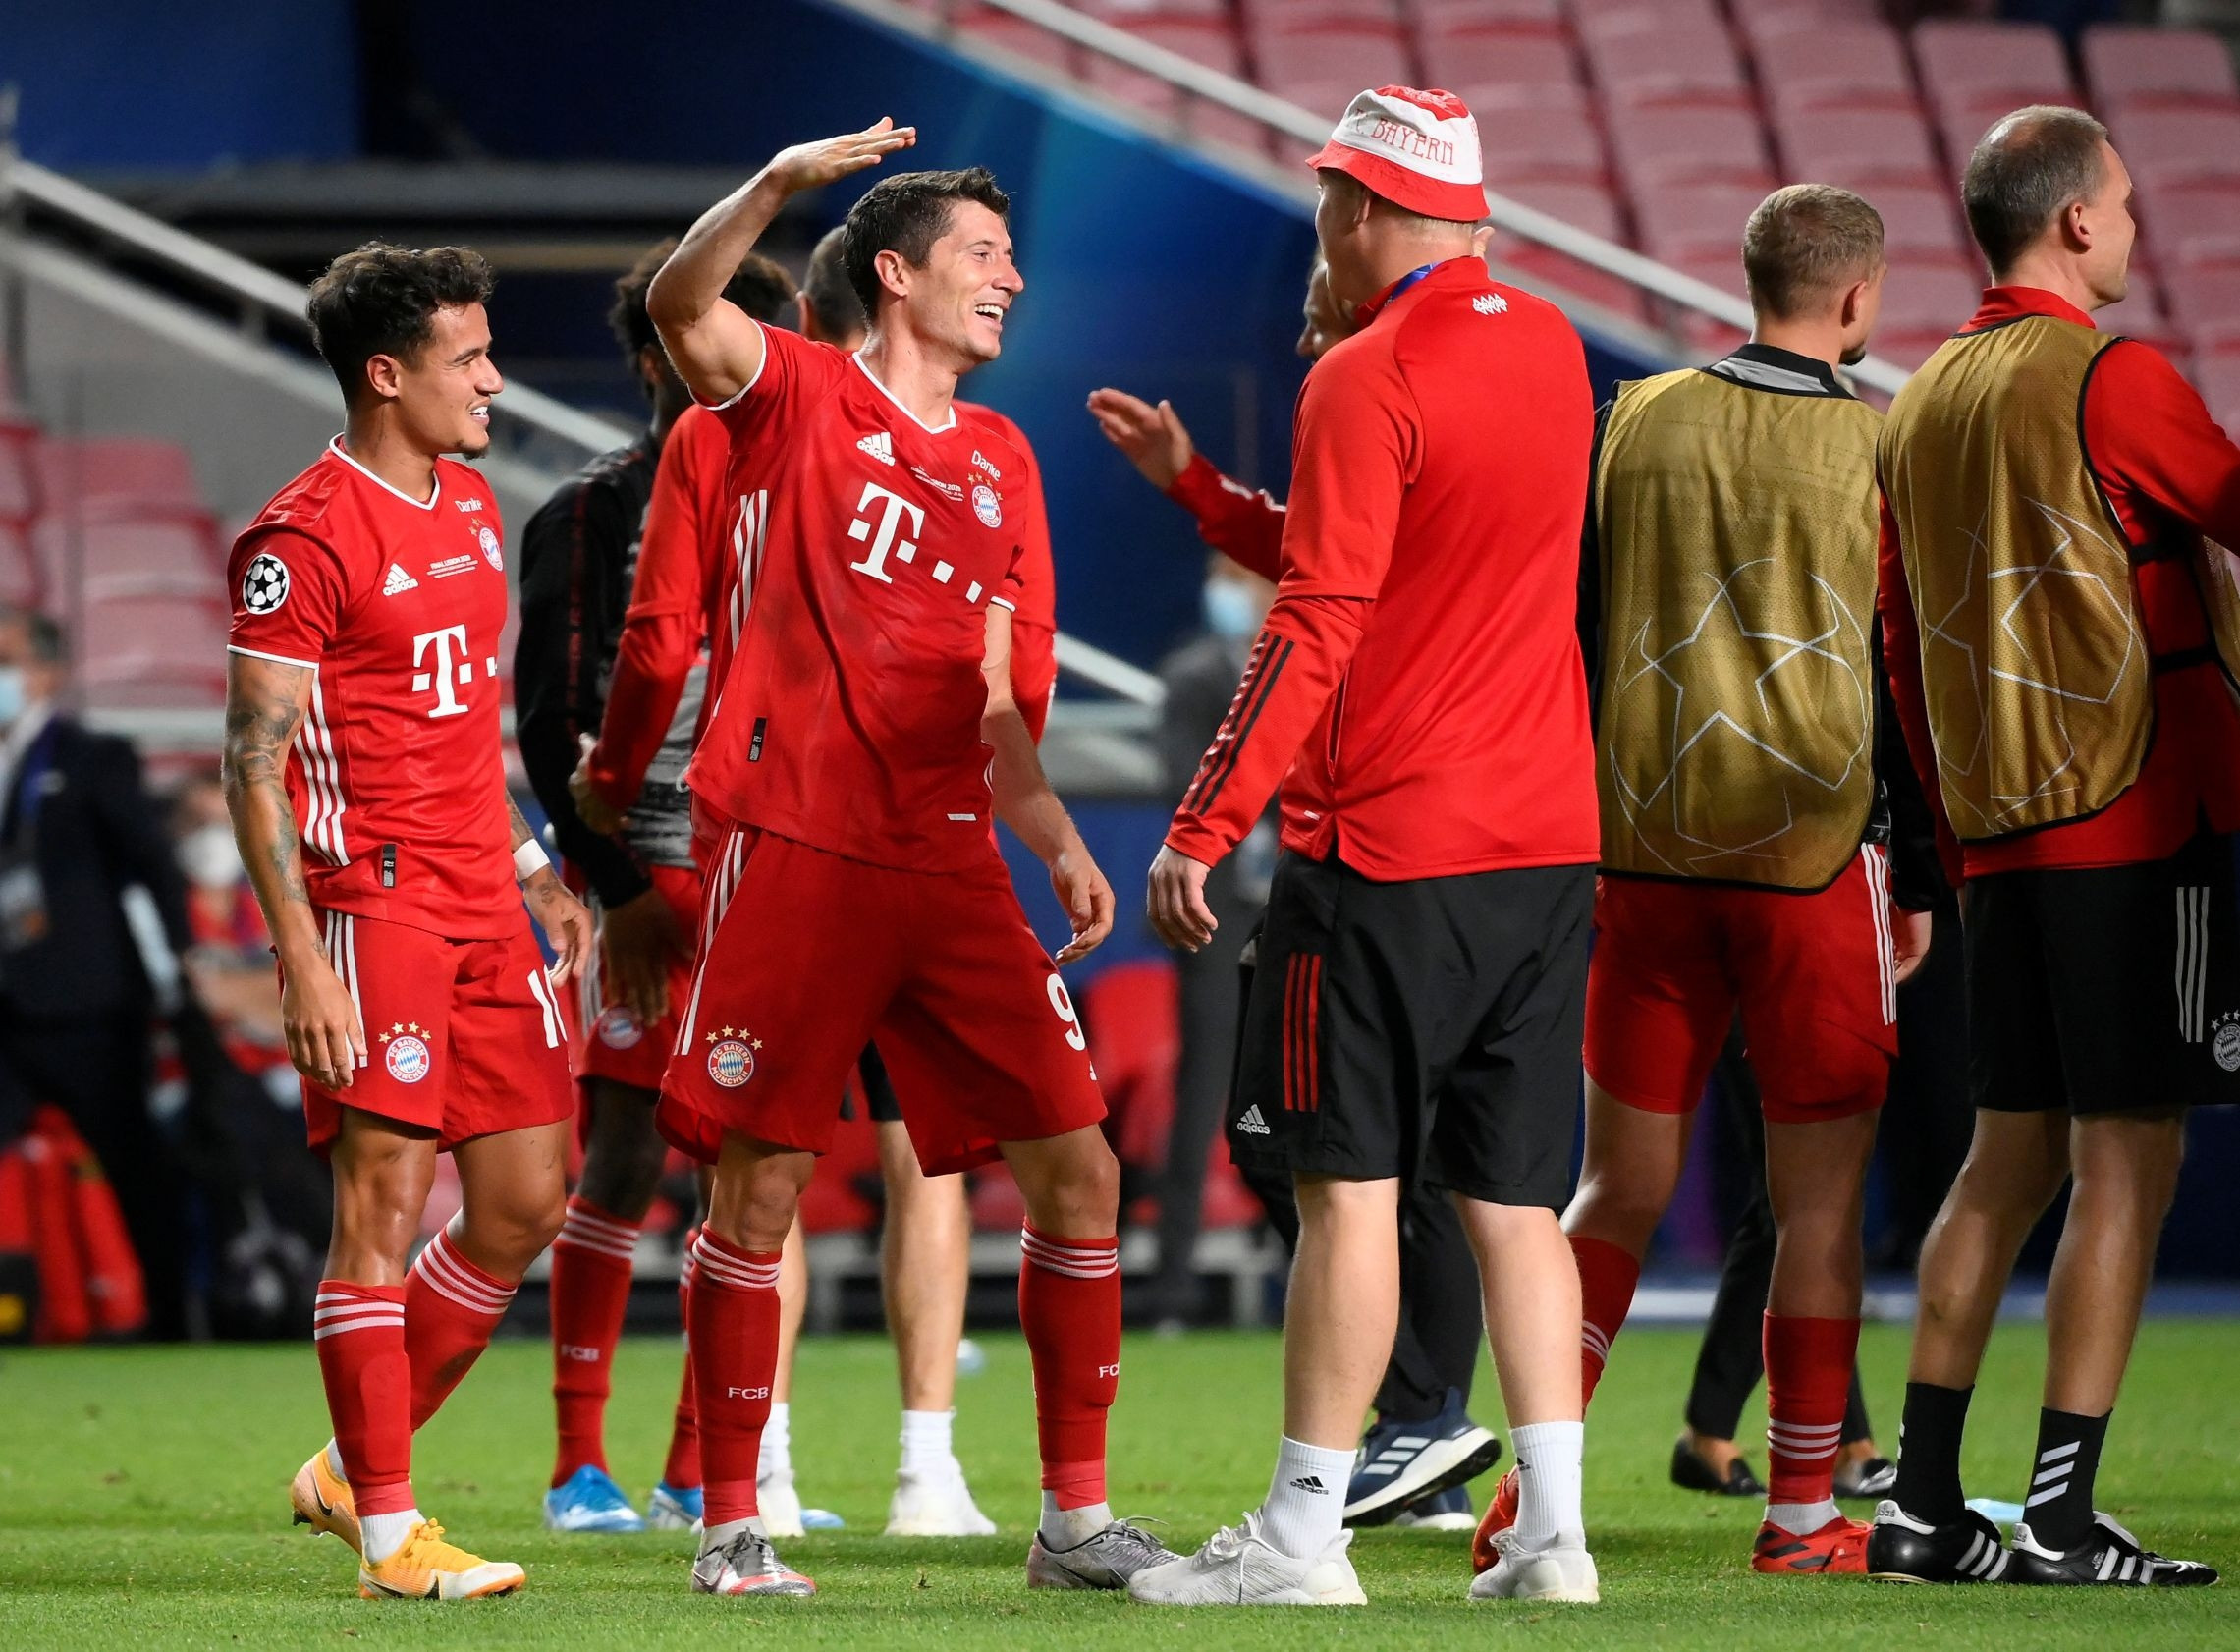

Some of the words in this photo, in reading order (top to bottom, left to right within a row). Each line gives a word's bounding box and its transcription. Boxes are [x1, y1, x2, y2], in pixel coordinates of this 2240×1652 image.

[1371, 117, 1453, 165] BAYERN
[856, 440, 896, 467] adidas
[971, 449, 1002, 482] Danke
[383, 578, 419, 596] adidas
[1046, 973, 1086, 1051] 9
[397, 1039, 426, 1057] BAYERN
[712, 1048, 723, 1060] FC
[723, 1043, 751, 1064] BAYERN
[1237, 1120, 1271, 1135] adidas
[561, 1344, 599, 1362] FCB
[1099, 1362, 1120, 1378] FC
[728, 1386, 769, 1400] FCB
[1290, 1480, 1329, 1495] adidas
